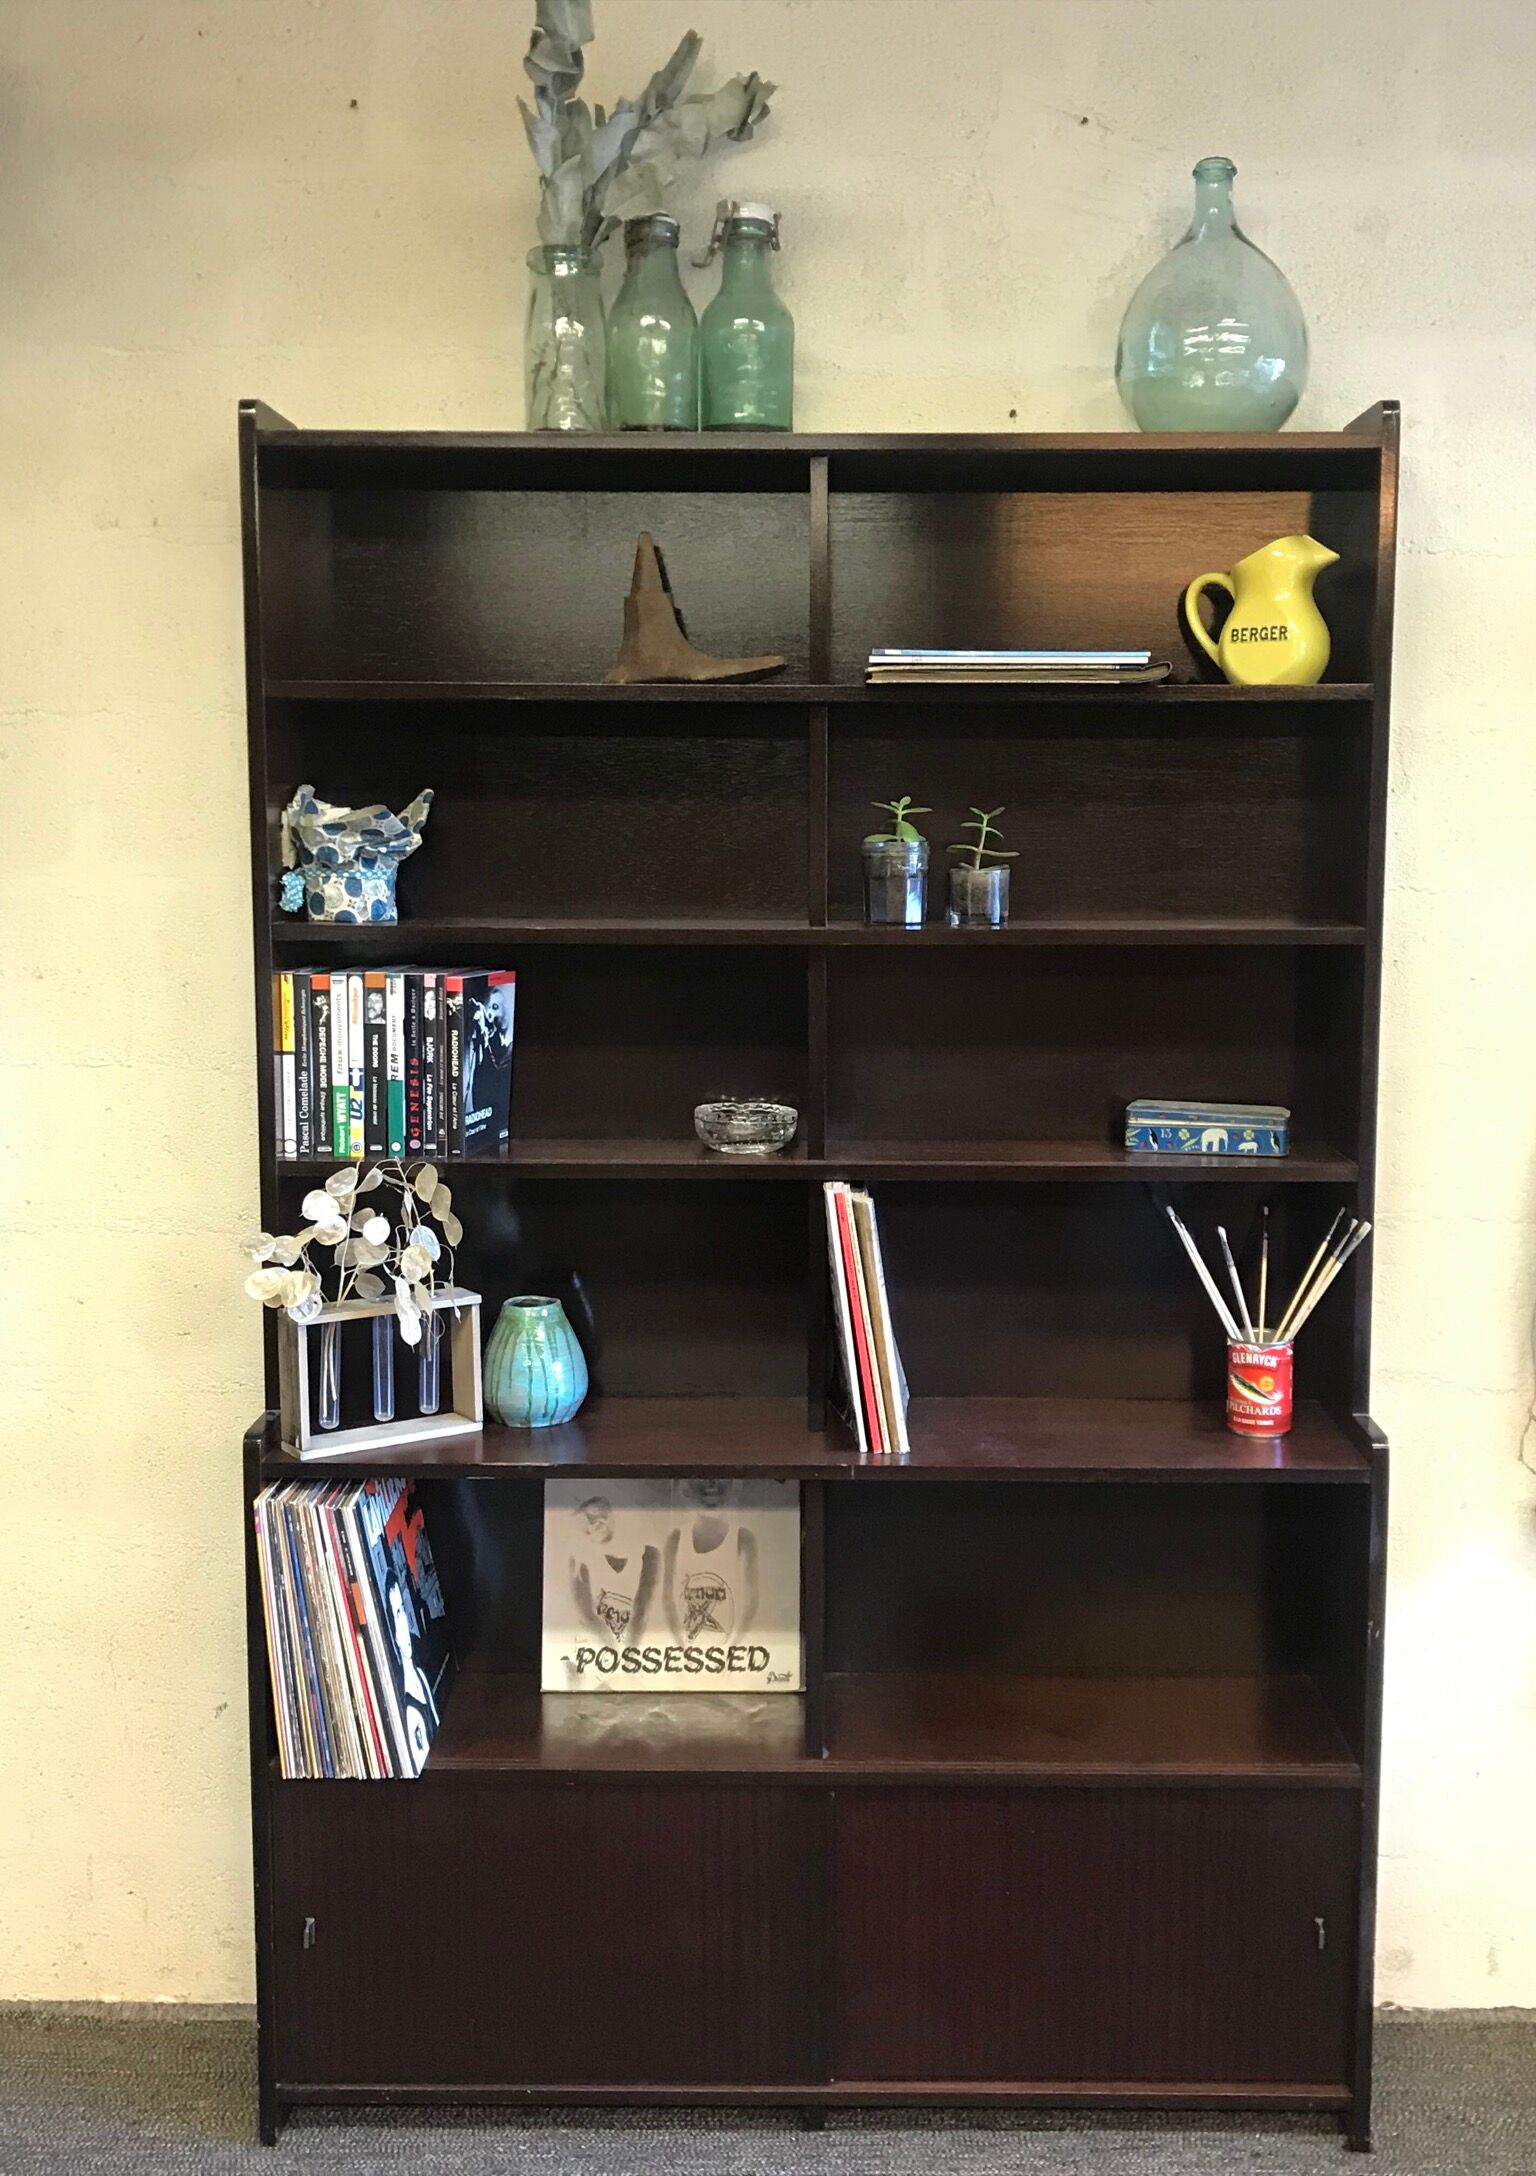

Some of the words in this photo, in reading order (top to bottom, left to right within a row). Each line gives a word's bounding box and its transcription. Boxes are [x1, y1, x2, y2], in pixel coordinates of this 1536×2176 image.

[1231, 626, 1288, 643] BERGER
[335, 993, 343, 1046] mouvements
[318, 1026, 327, 1064] DEPECHE
[451, 1029, 459, 1078] RADIOHEAD
[319, 1064, 328, 1089] MODE
[390, 1053, 399, 1081] REM
[298, 1070, 310, 1119] Comelade
[335, 1092, 347, 1123] WYATT
[350, 1098, 363, 1121] U2
[409, 1057, 421, 1137] GENESIS
[425, 1095, 433, 1131] Septentrion
[465, 1106, 493, 1126] RADIOHEAD
[299, 1122, 310, 1154] Pascal
[338, 1125, 346, 1154] Robert
[1232, 1352, 1278, 1368] GLENRYCK
[1229, 1400, 1281, 1416] PILCHARDS
[575, 1645, 771, 1675] POSSESSED
